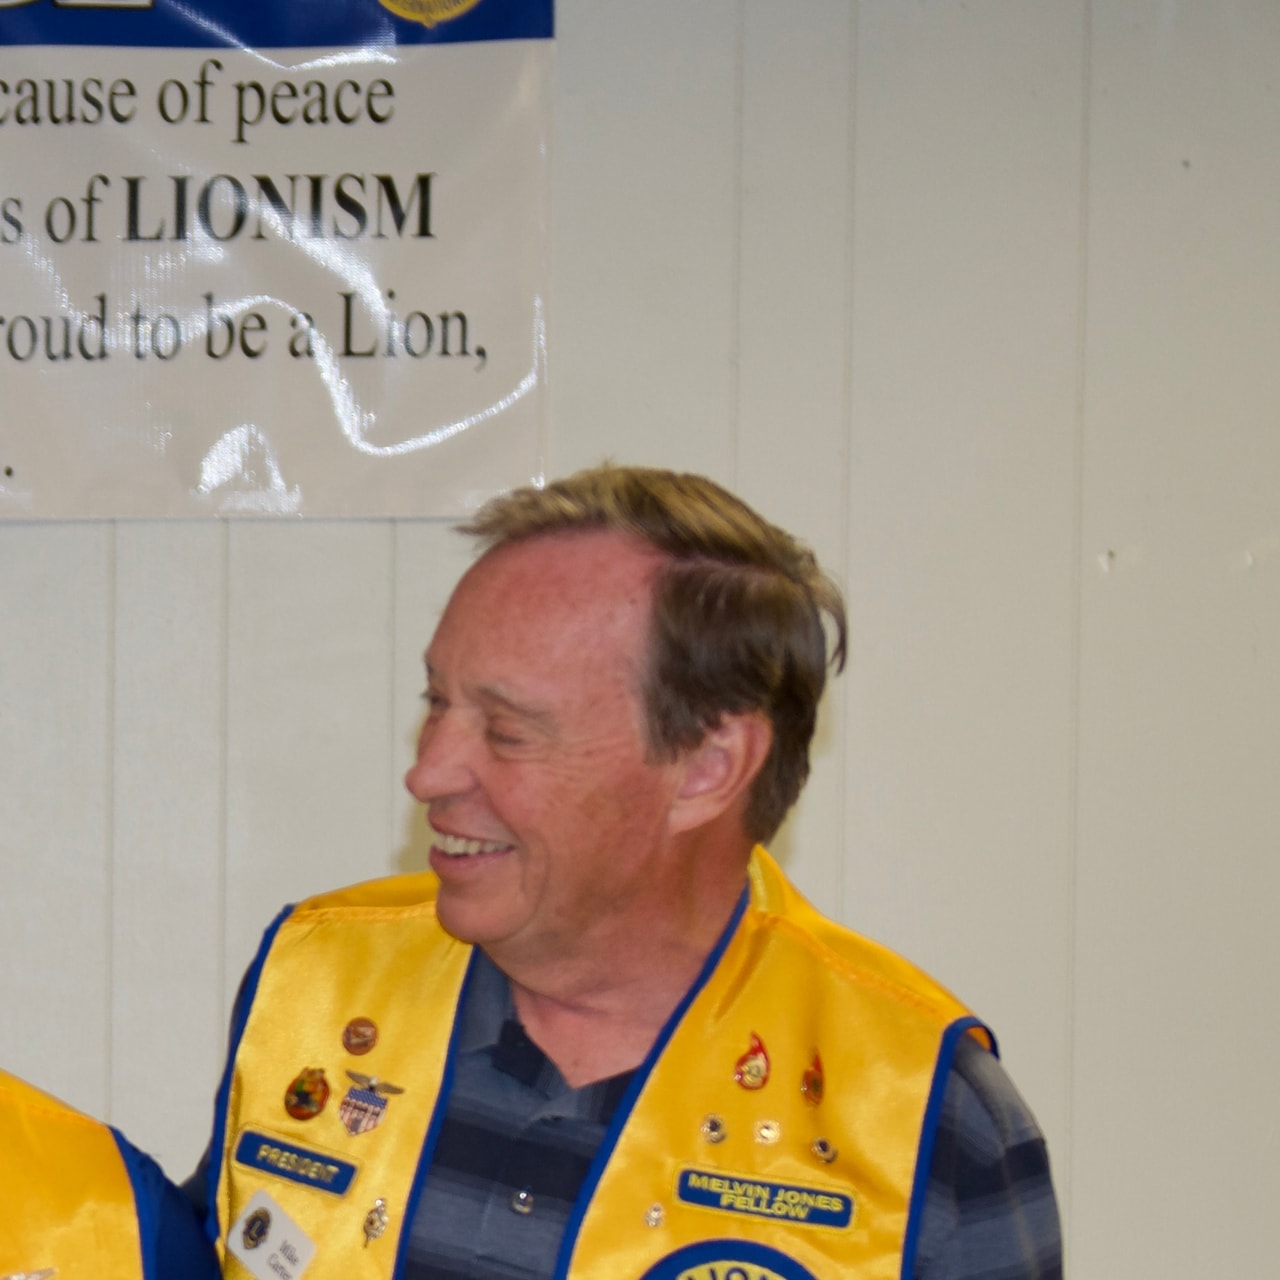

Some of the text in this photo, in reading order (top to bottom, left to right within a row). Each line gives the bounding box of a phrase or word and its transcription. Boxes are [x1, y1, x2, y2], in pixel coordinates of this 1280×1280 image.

[157, 60, 222, 124] of
[233, 79, 394, 144] peace
[45, 174, 110, 244] of
[122, 173, 435, 242] LIONISM
[131, 308, 180, 361] to
[203, 292, 267, 360] be
[288, 313, 314, 359] a
[338, 290, 487, 371] Lion,
[255, 1143, 340, 1184] PRESIDENT
[688, 1173, 843, 1212] MELVIN JONES
[720, 1192, 810, 1220] FELLOW
